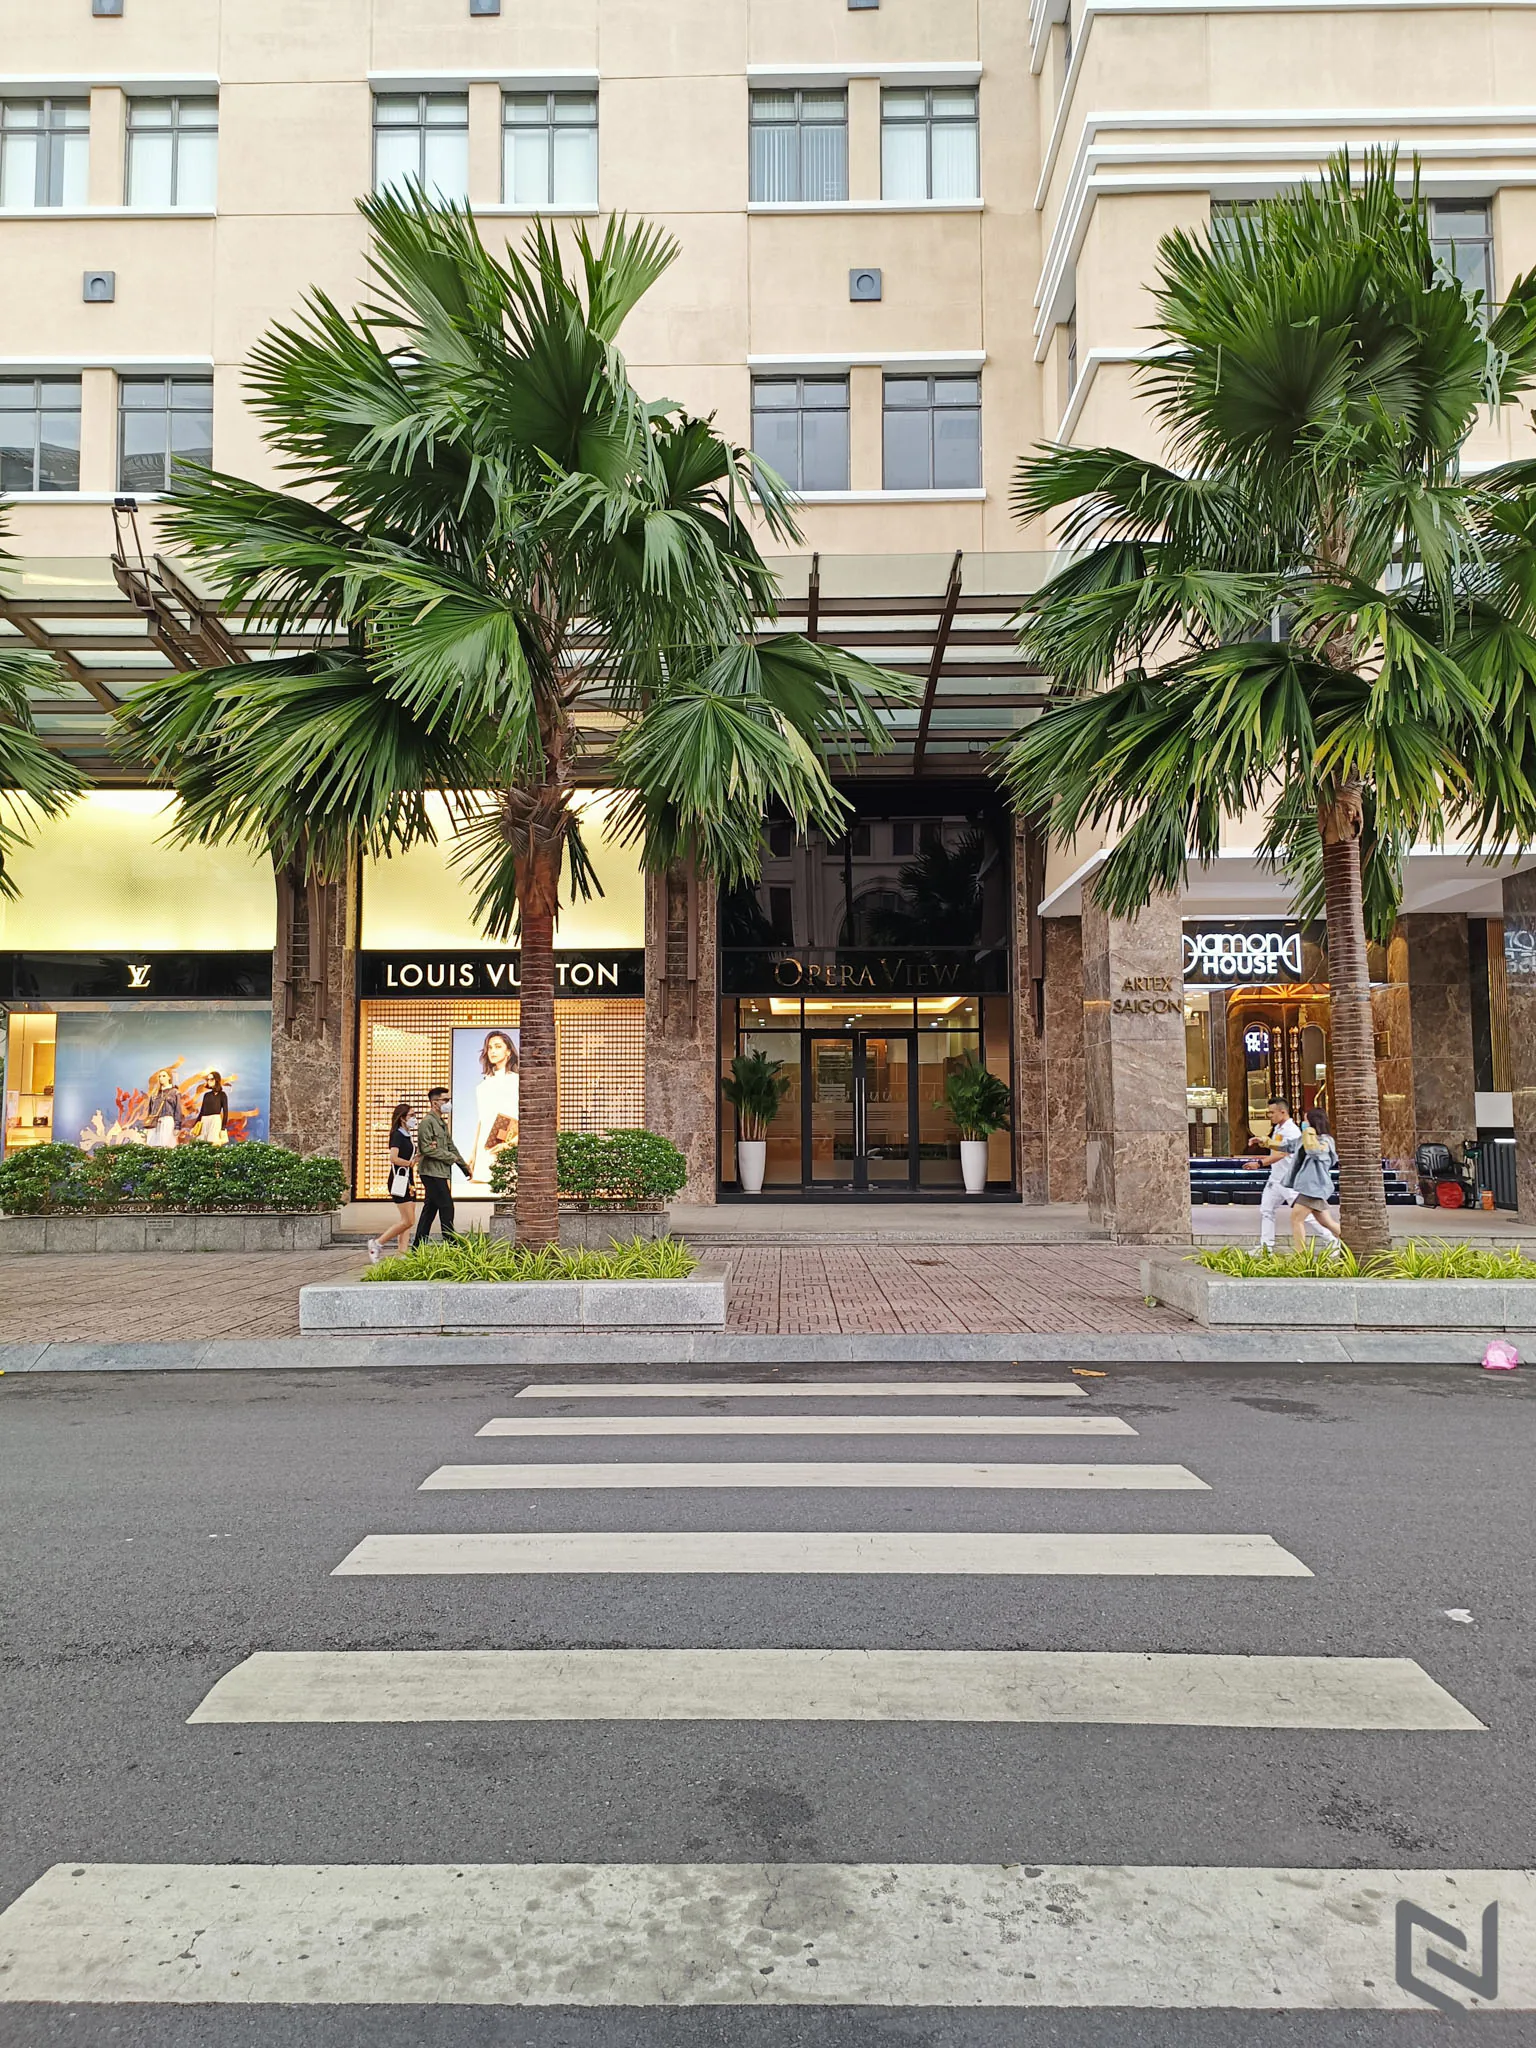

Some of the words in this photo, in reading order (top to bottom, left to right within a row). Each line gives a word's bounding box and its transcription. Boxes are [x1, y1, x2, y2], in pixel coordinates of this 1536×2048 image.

[386, 963, 475, 988] LOUIS
[486, 962, 619, 988] VUTON
[774, 957, 876, 987] OPERA
[877, 957, 960, 987] VIEW
[1202, 954, 1278, 975] HOUSE
[1121, 976, 1173, 993] ARTEX
[1112, 998, 1182, 1016] SAIGON
